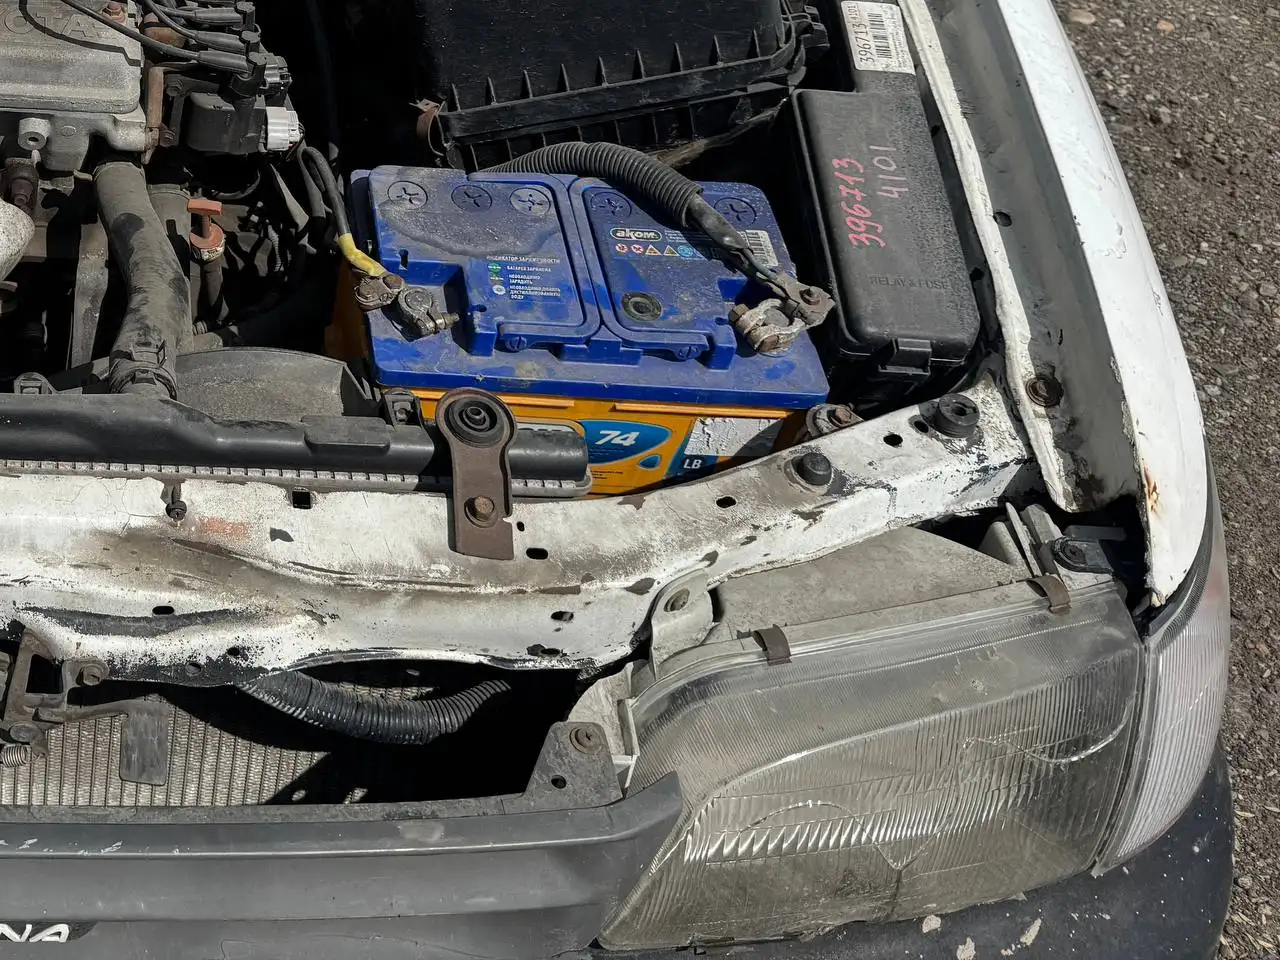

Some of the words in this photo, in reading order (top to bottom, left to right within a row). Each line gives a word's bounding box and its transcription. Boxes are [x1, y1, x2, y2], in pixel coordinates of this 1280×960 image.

[852, 23, 875, 62] 396713
[869, 145, 908, 199] 4101
[831, 158, 886, 248] 396713
[595, 430, 640, 447] 74
[683, 458, 702, 469] LB
